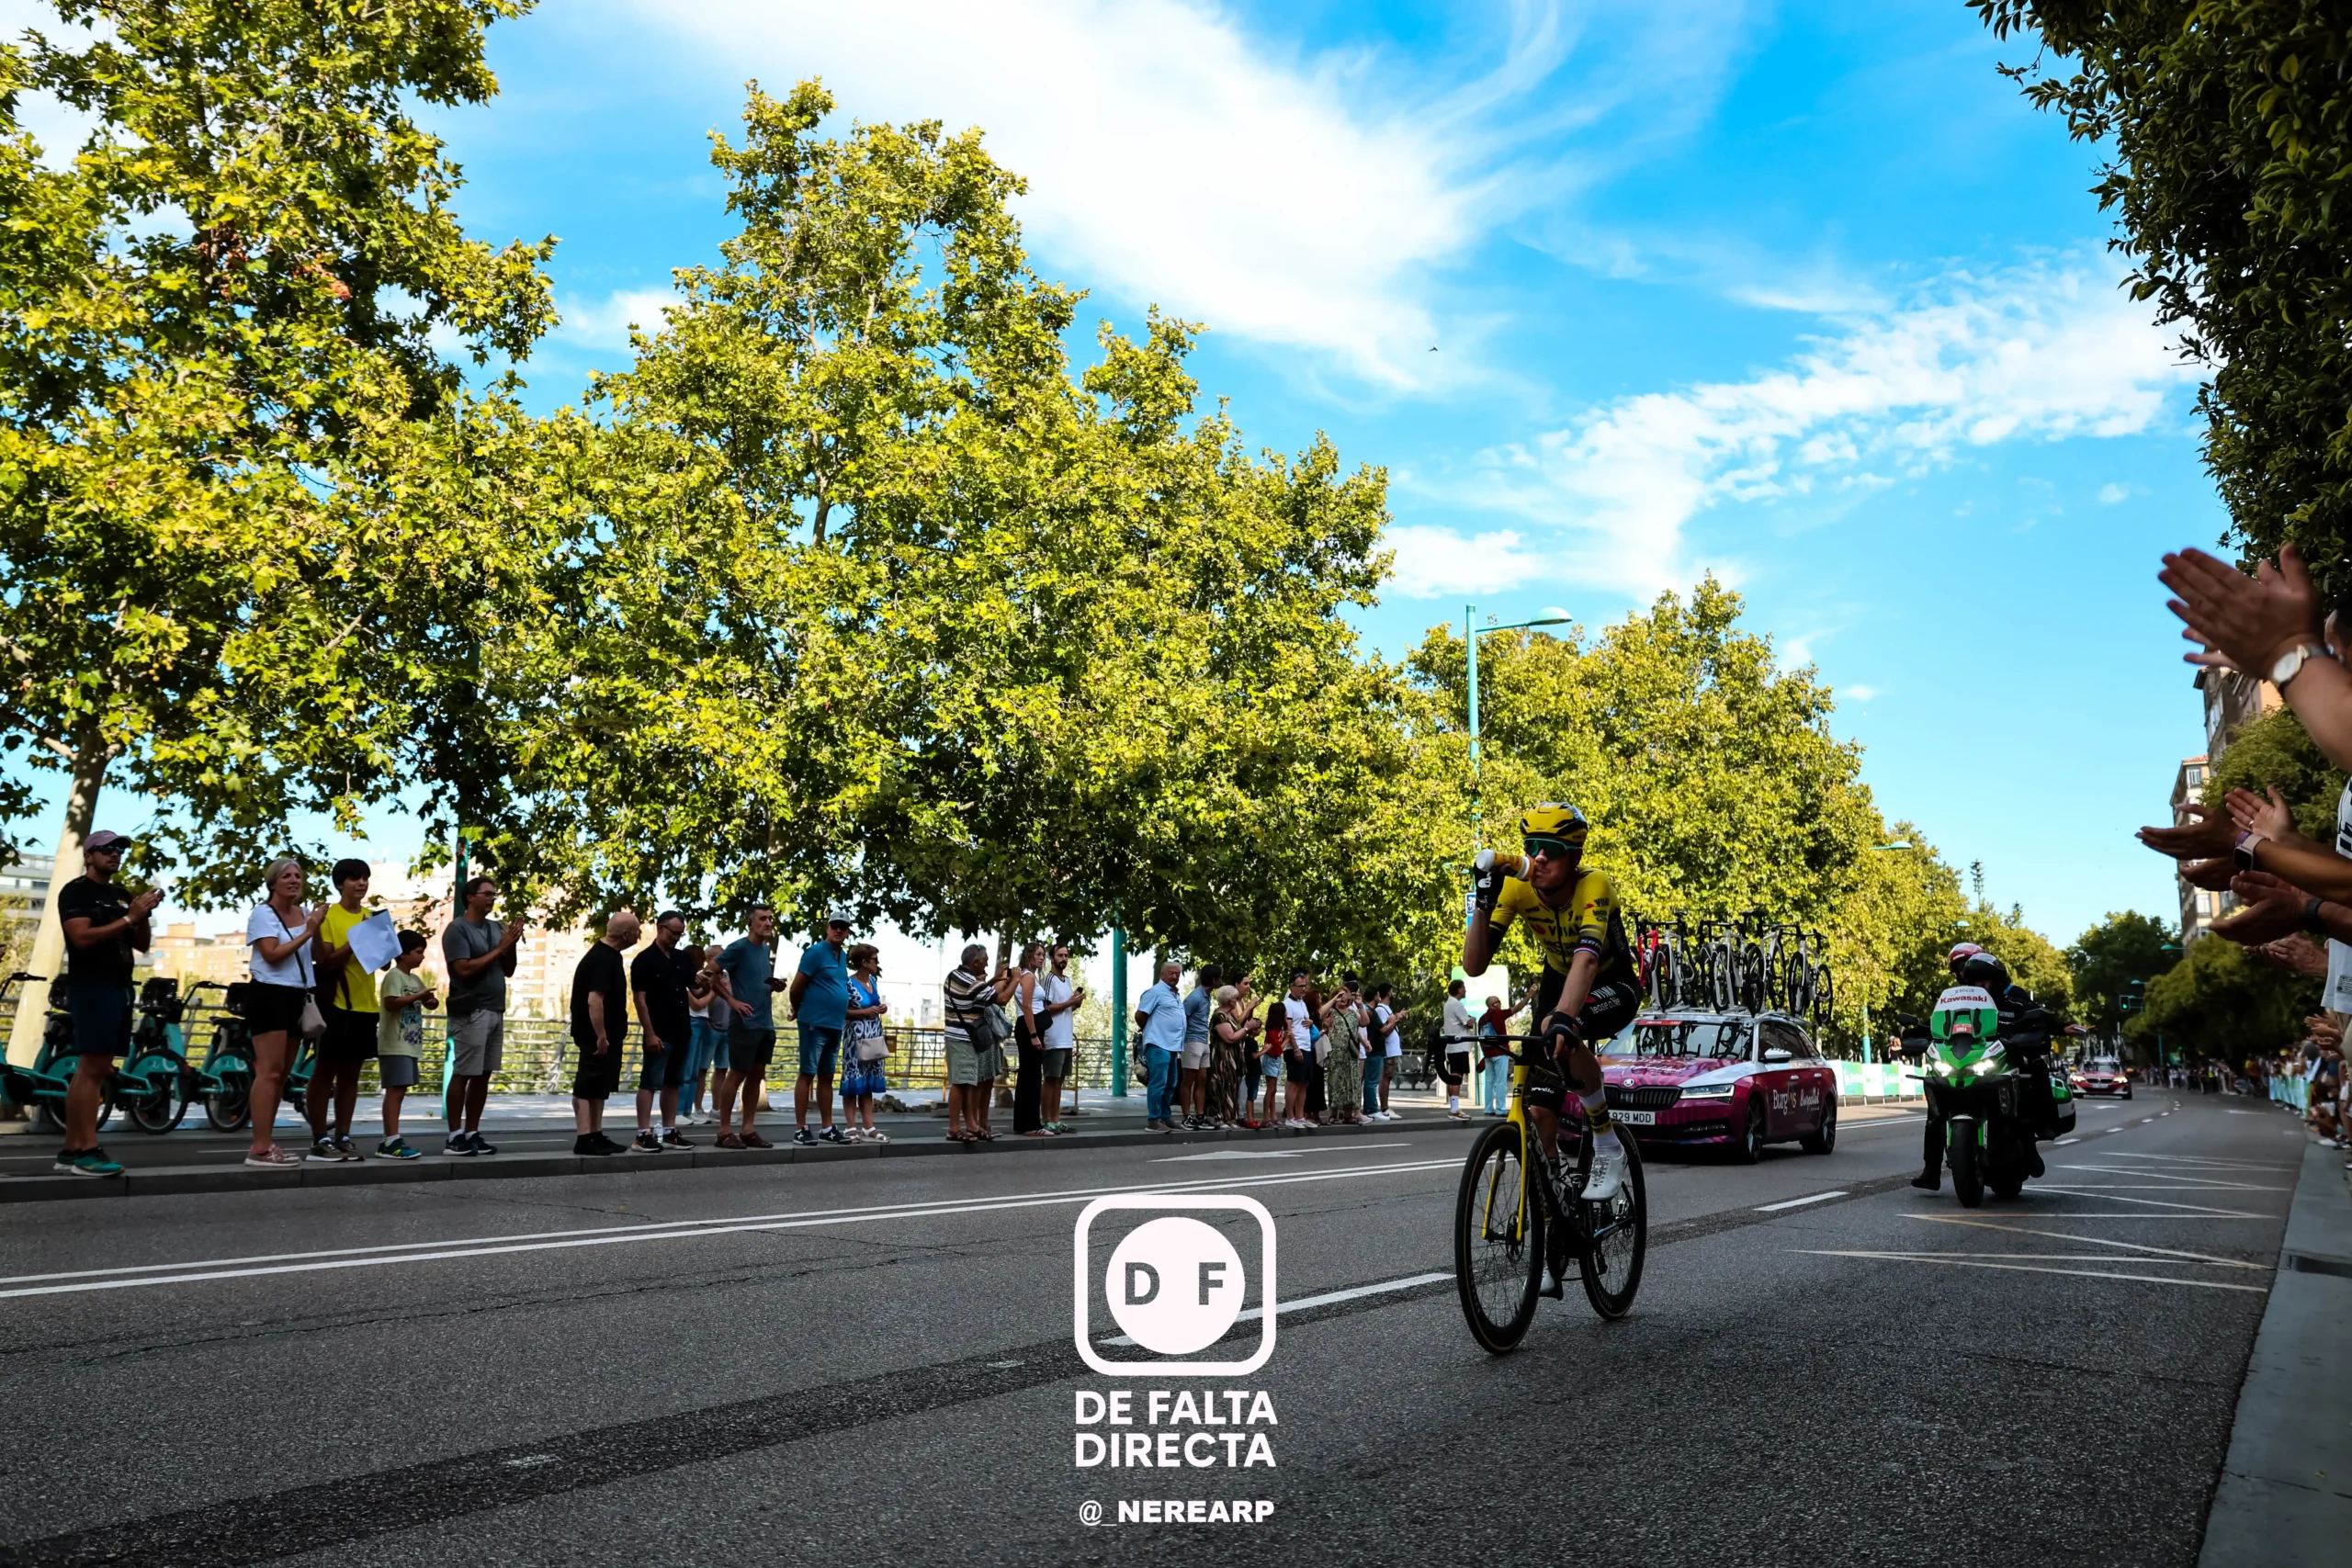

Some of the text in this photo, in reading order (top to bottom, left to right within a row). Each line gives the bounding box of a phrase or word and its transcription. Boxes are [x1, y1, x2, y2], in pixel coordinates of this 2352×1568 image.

[1939, 995, 1988, 1004] Kawasaki
[1531, 1087, 1555, 1095] rvélo
[1609, 1112, 1652, 1123] 929 MDD
